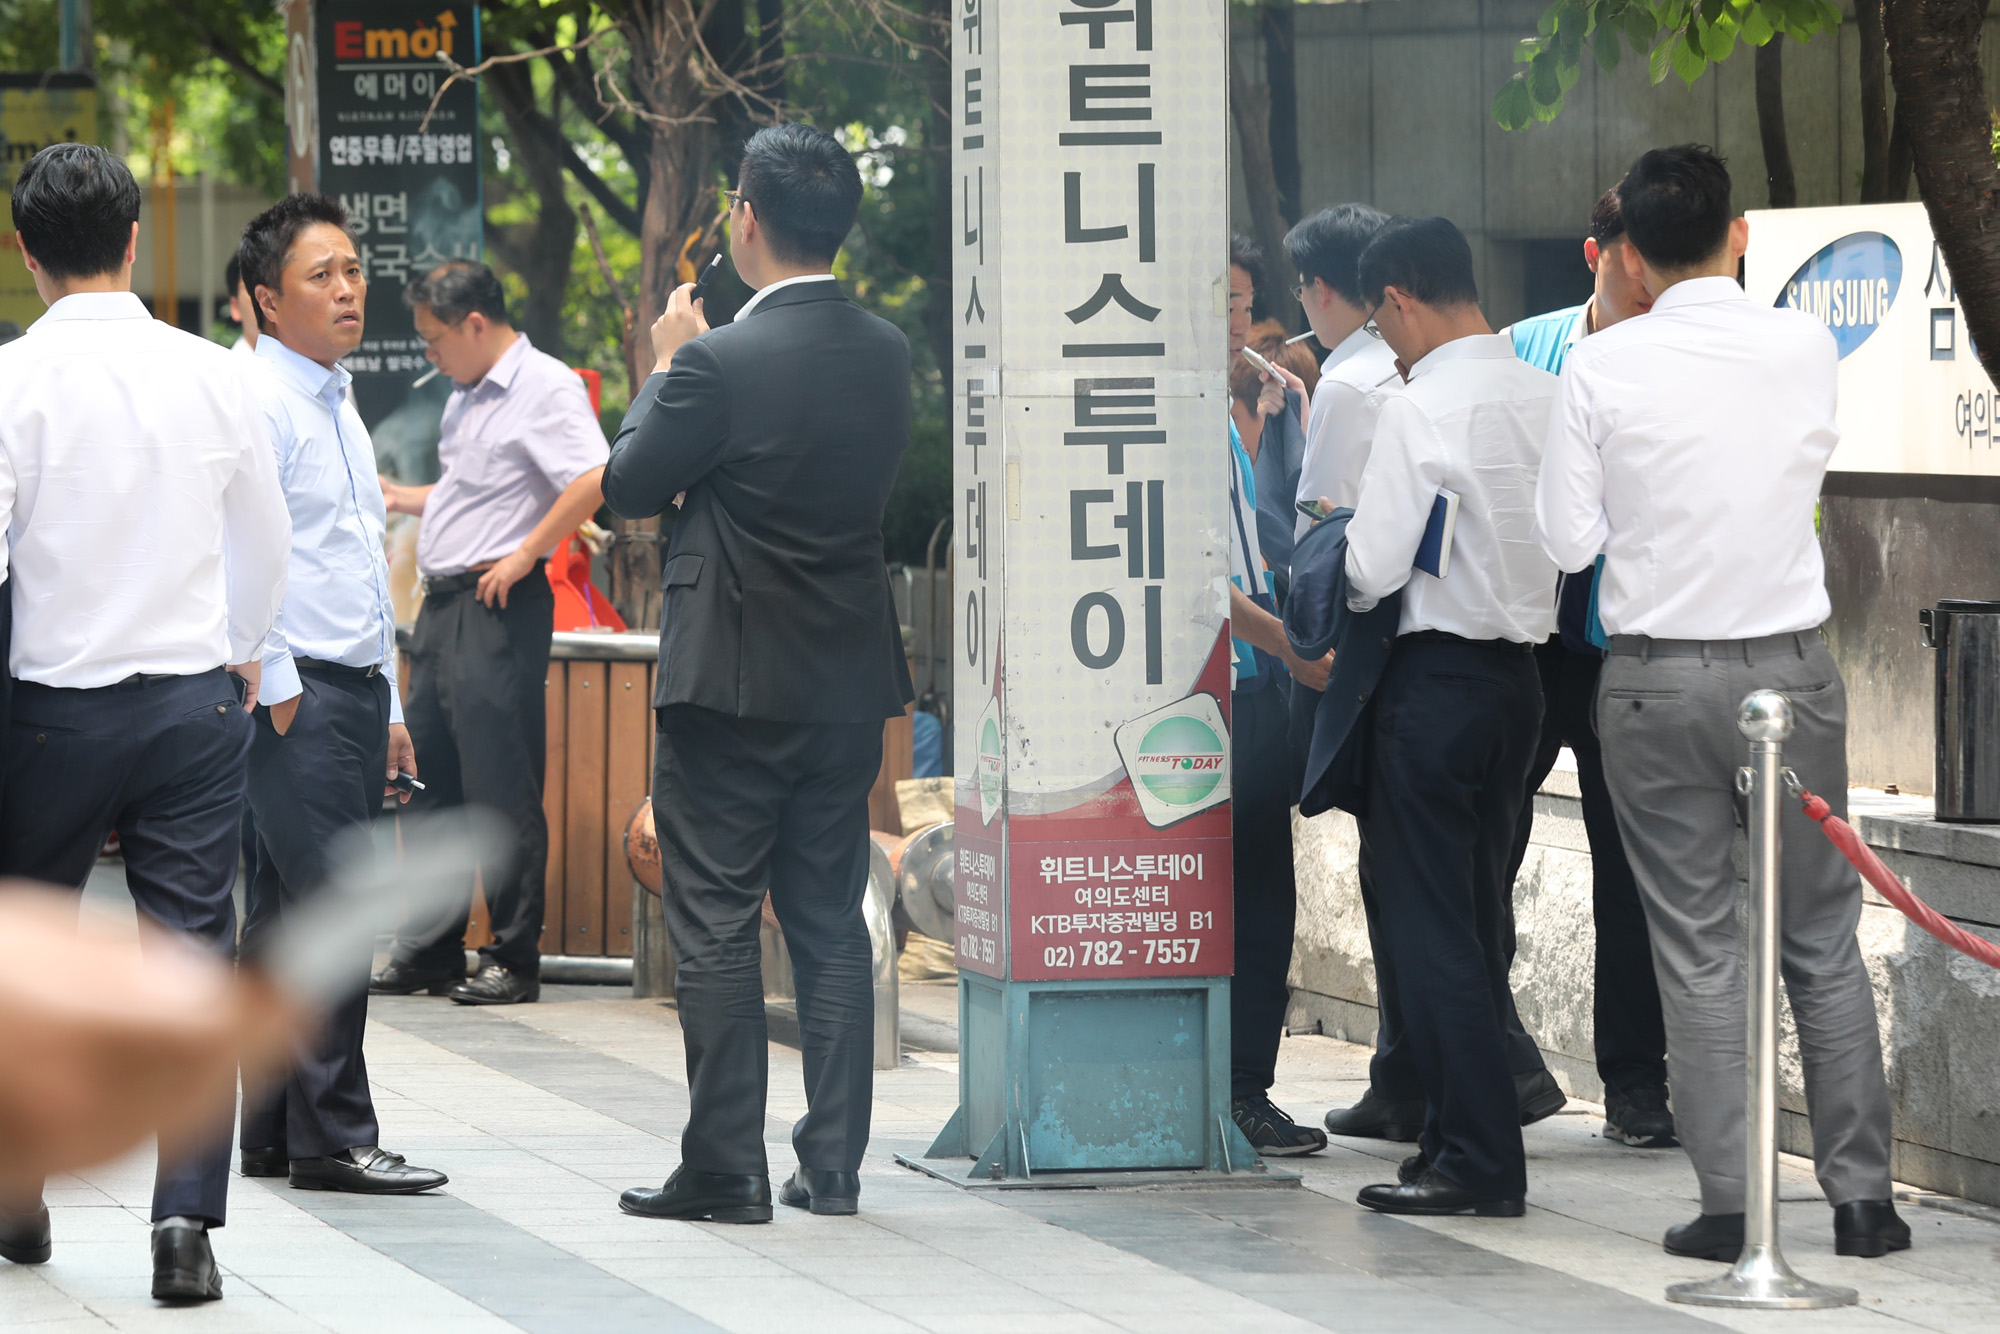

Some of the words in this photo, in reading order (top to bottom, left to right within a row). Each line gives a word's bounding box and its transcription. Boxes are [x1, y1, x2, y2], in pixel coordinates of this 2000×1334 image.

[354, 72, 436, 100] 에머이
[1786, 277, 1890, 327] SAMSUNG
[1138, 755, 1170, 763] FITNESS
[1171, 757, 1224, 770] TODAY
[960, 848, 996, 882] 휘트니스투데이
[1039, 854, 1203, 884] 휘트니스투데이
[966, 881, 988, 905] 여의도센터
[1074, 885, 1169, 908] 여의도센터
[1031, 911, 1178, 935] KTB투자증권빌딩
[1189, 910, 1213, 930] B1
